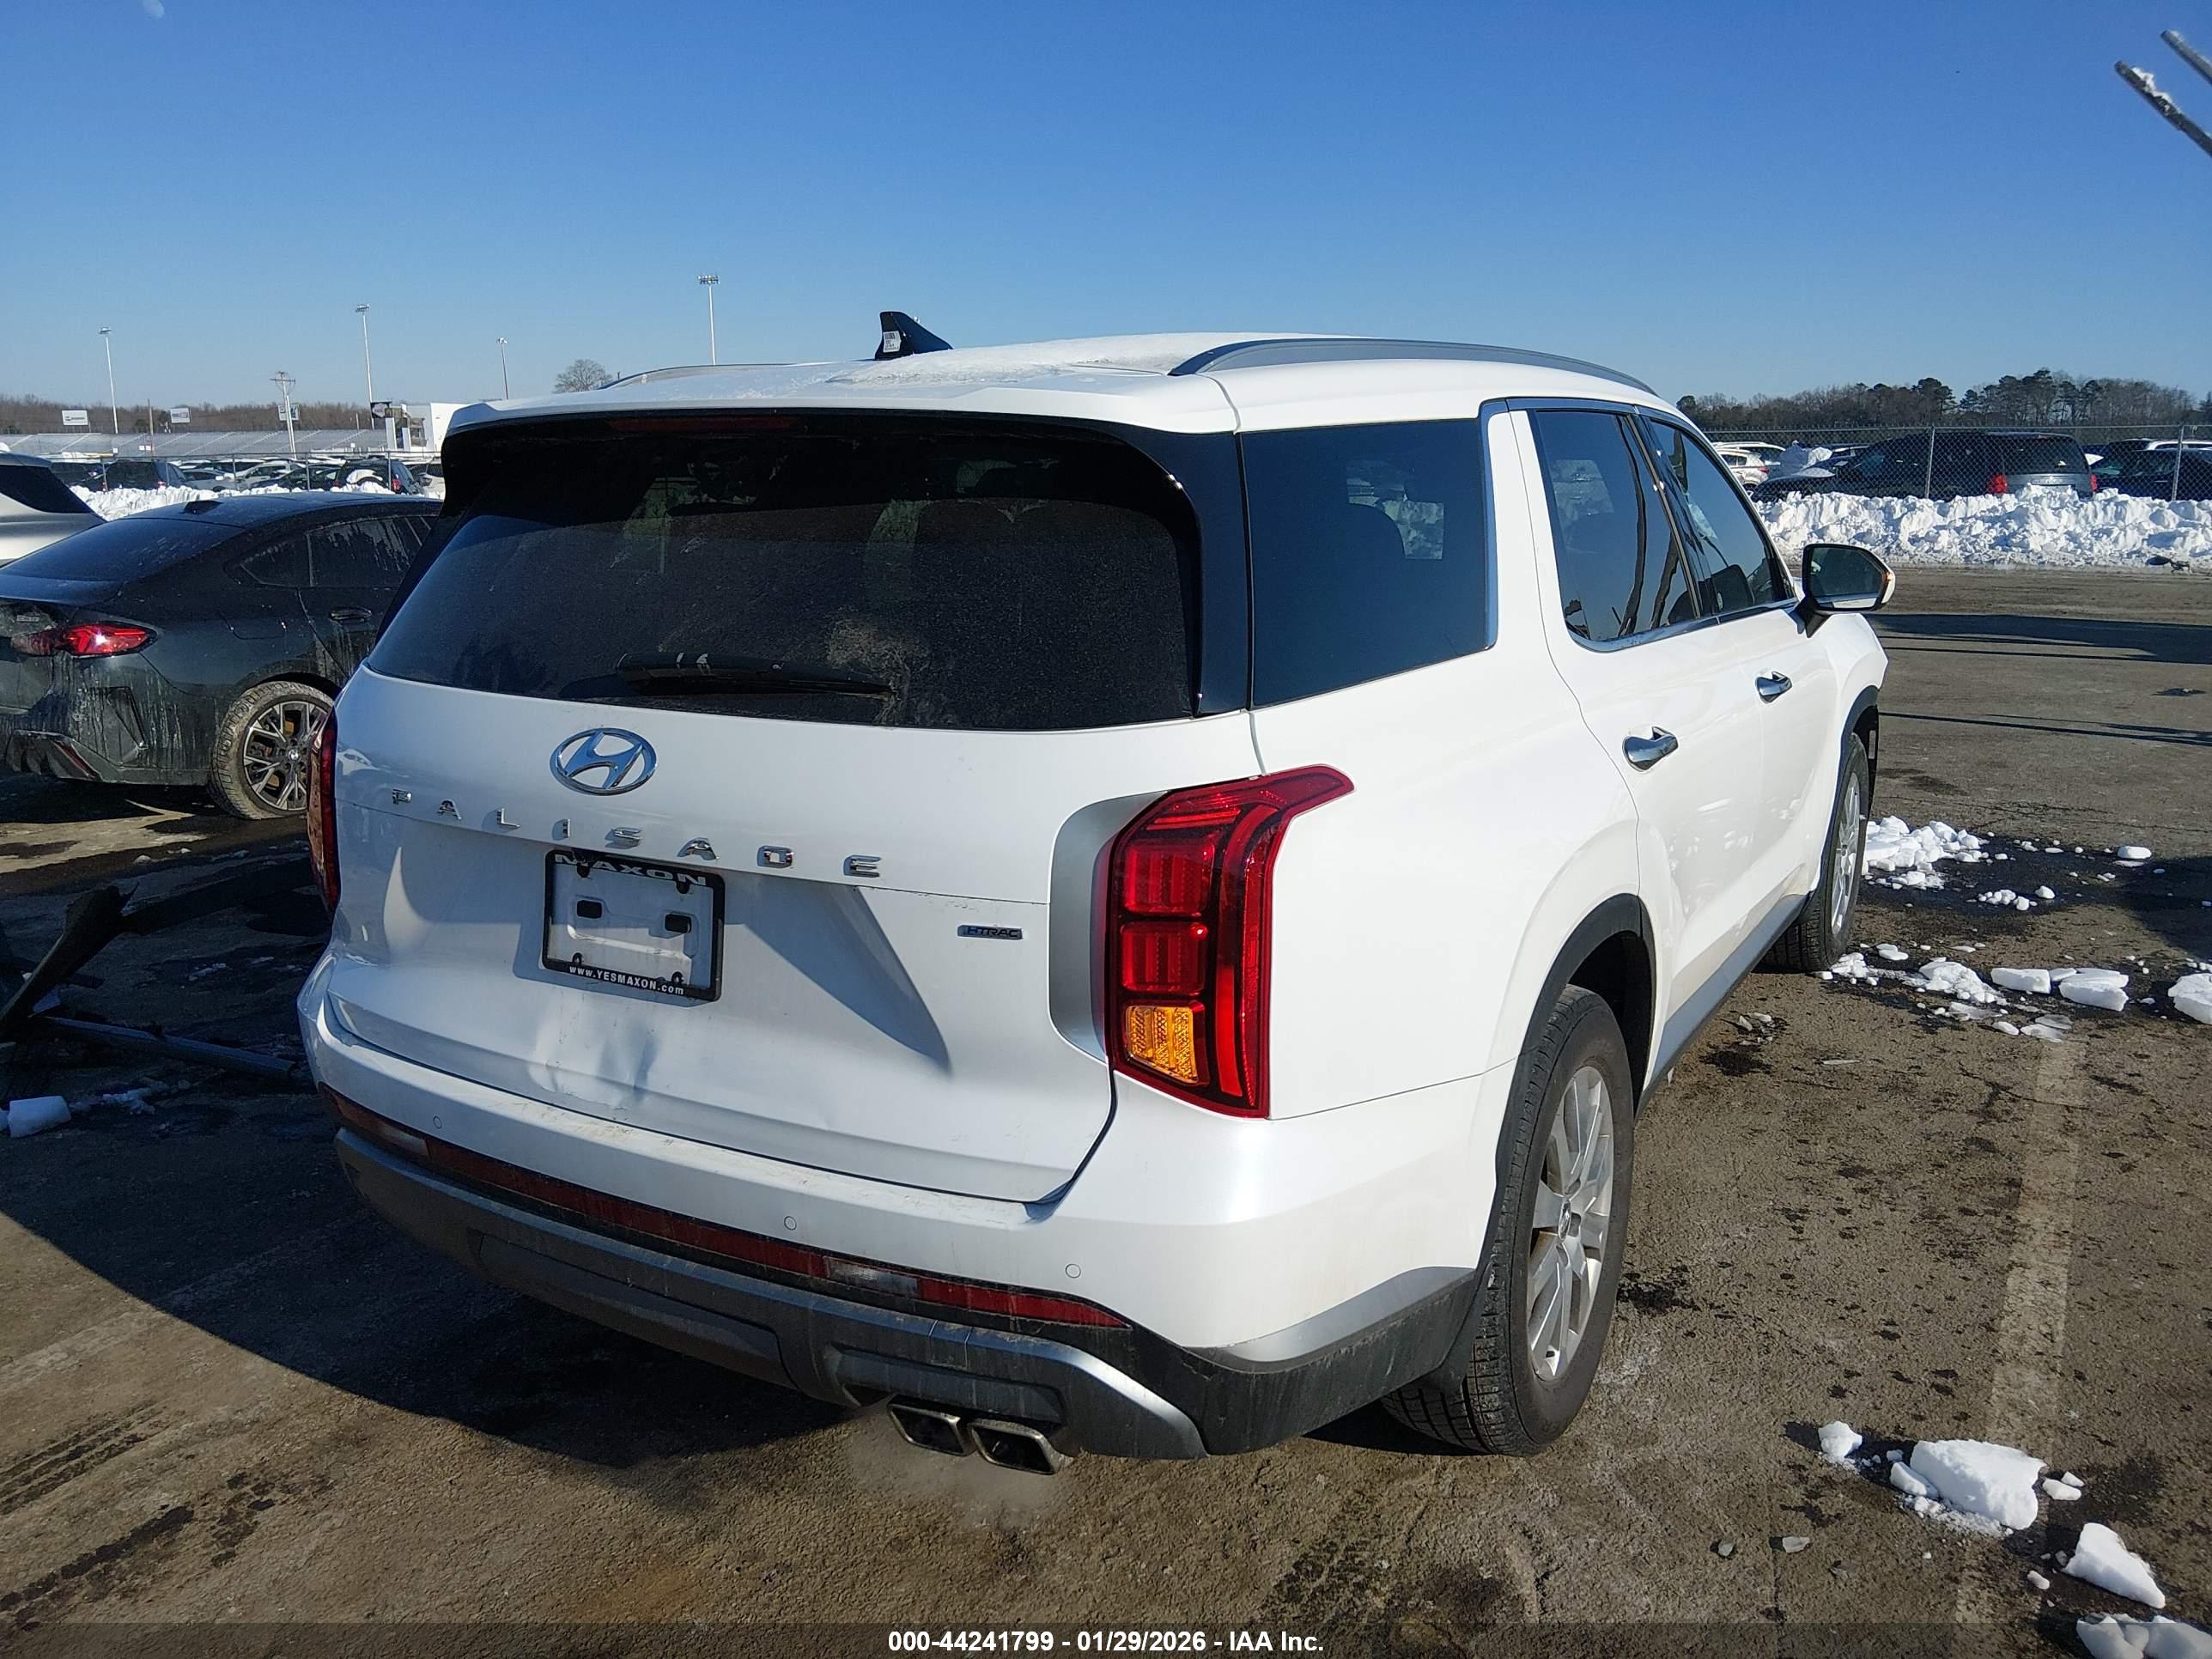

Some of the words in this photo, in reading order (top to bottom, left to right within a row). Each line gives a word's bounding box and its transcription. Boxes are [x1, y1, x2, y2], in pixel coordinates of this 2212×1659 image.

[391, 787, 882, 878] PALISADE
[554, 854, 707, 886] MAXON
[963, 926, 1020, 939] HTRAC
[568, 964, 685, 996] www.YESMAXON.com
